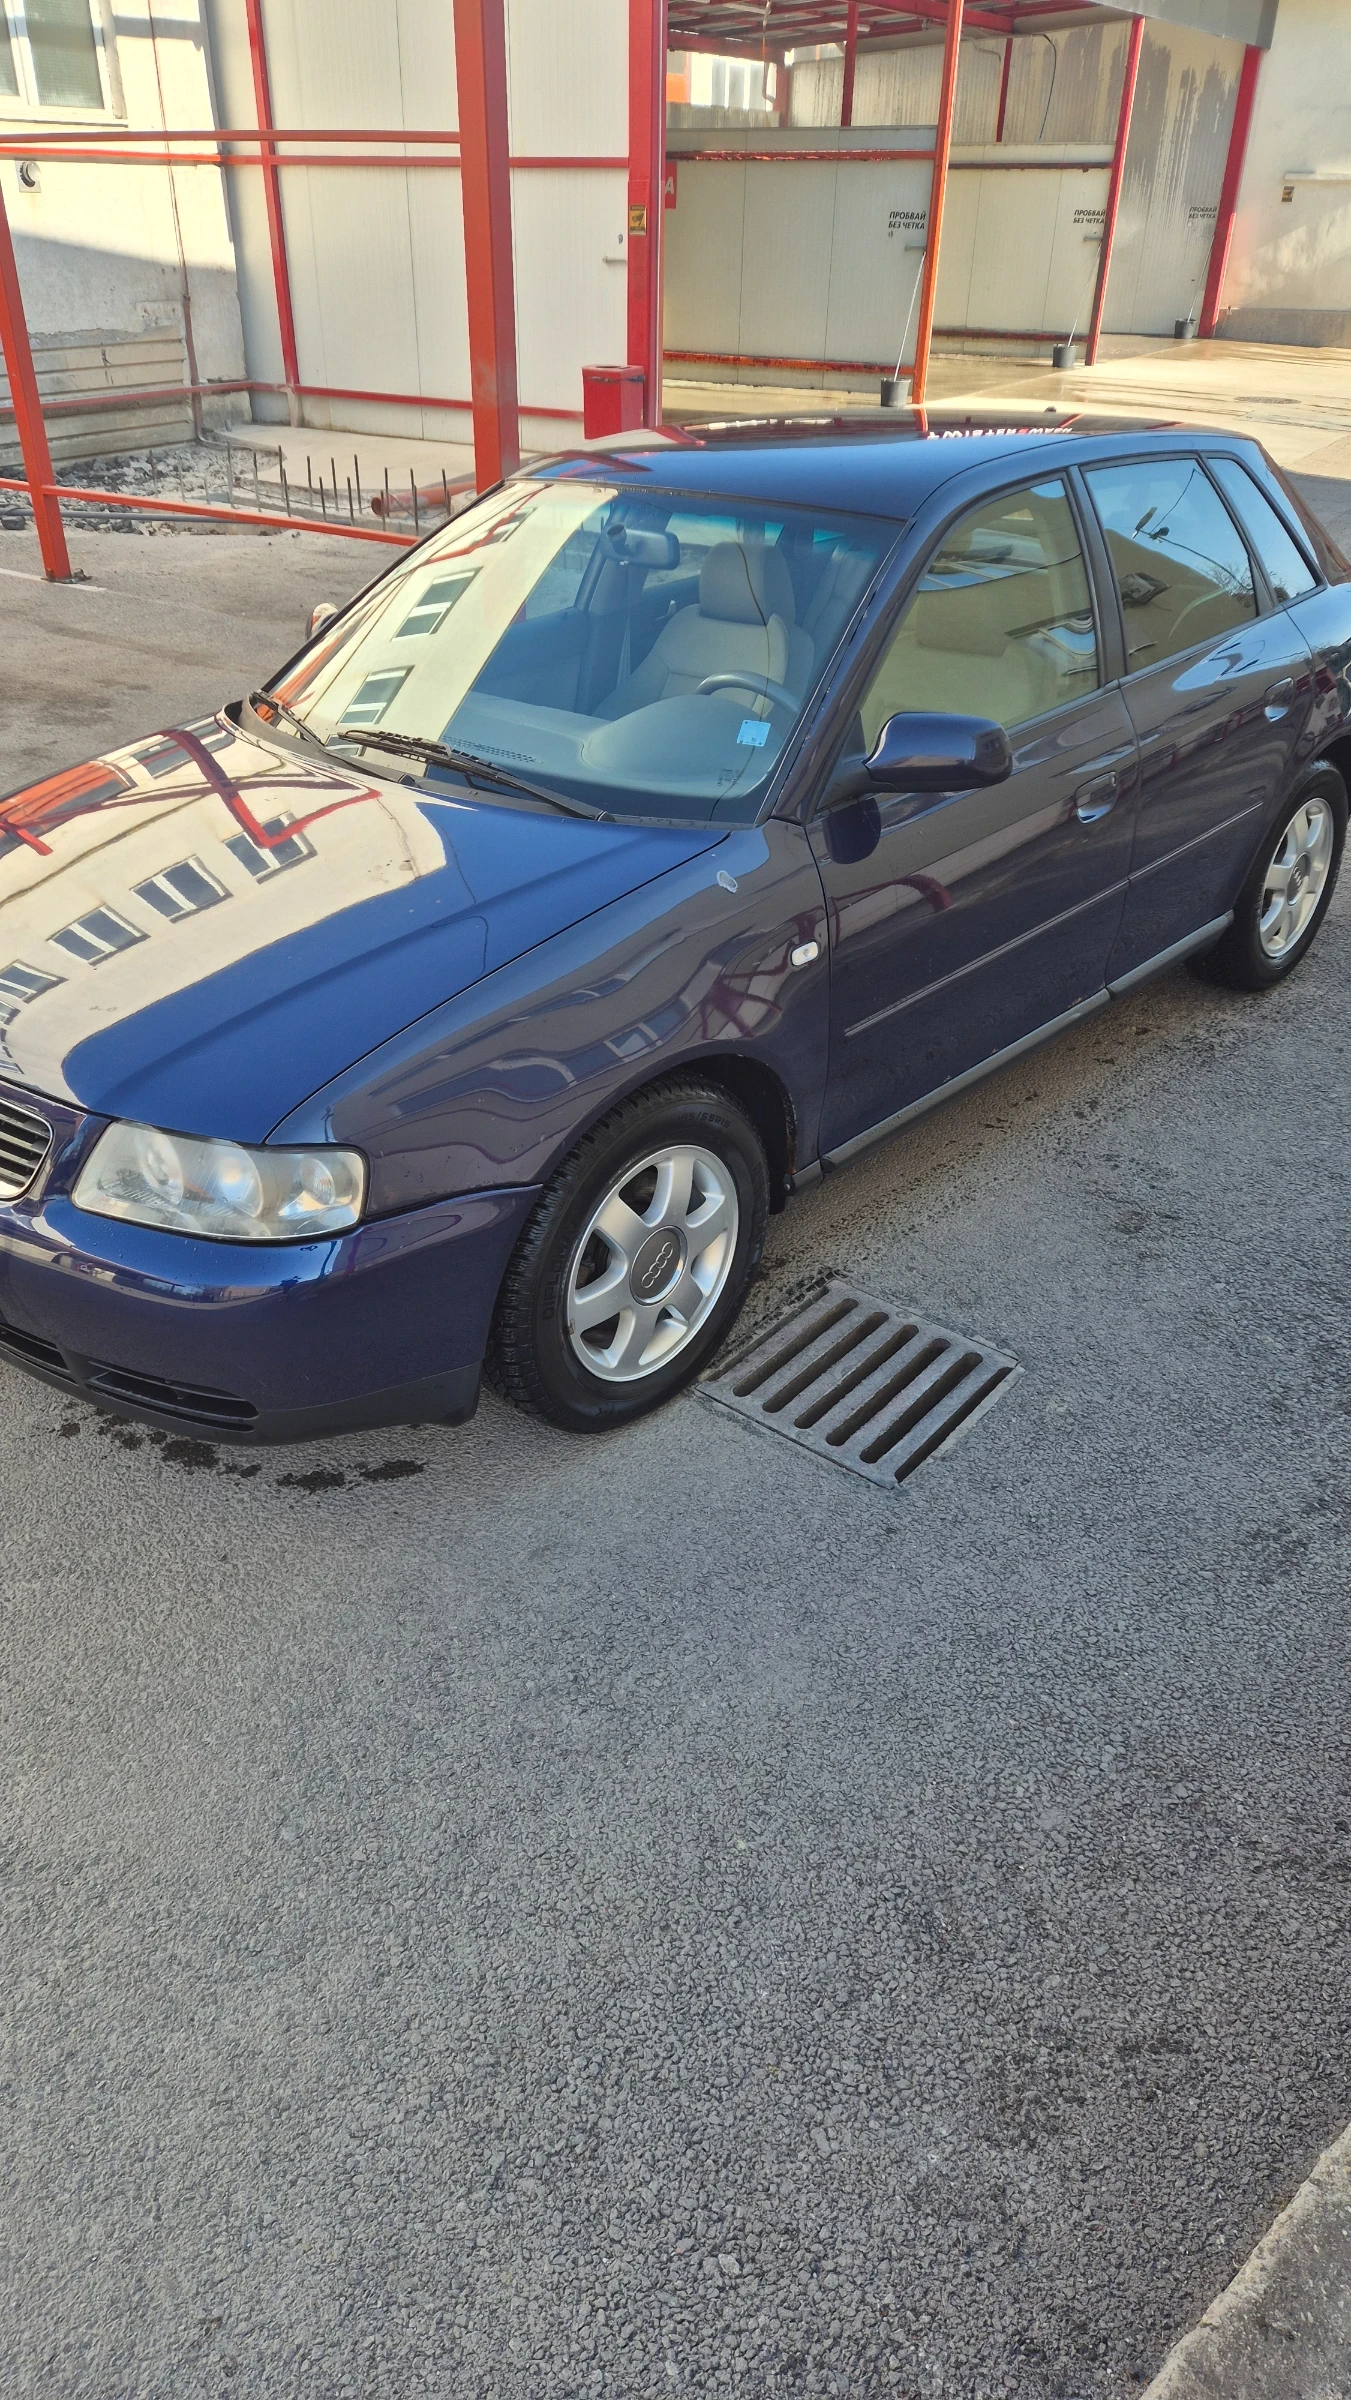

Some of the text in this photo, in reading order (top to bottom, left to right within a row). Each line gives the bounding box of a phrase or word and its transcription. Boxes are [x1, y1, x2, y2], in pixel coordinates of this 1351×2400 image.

[889, 211, 926, 220] ПРОБВАЙ
[1074, 209, 1106, 217] ПРОБВАЙ
[888, 221, 925, 230] БЕЗ ЧЕТКА
